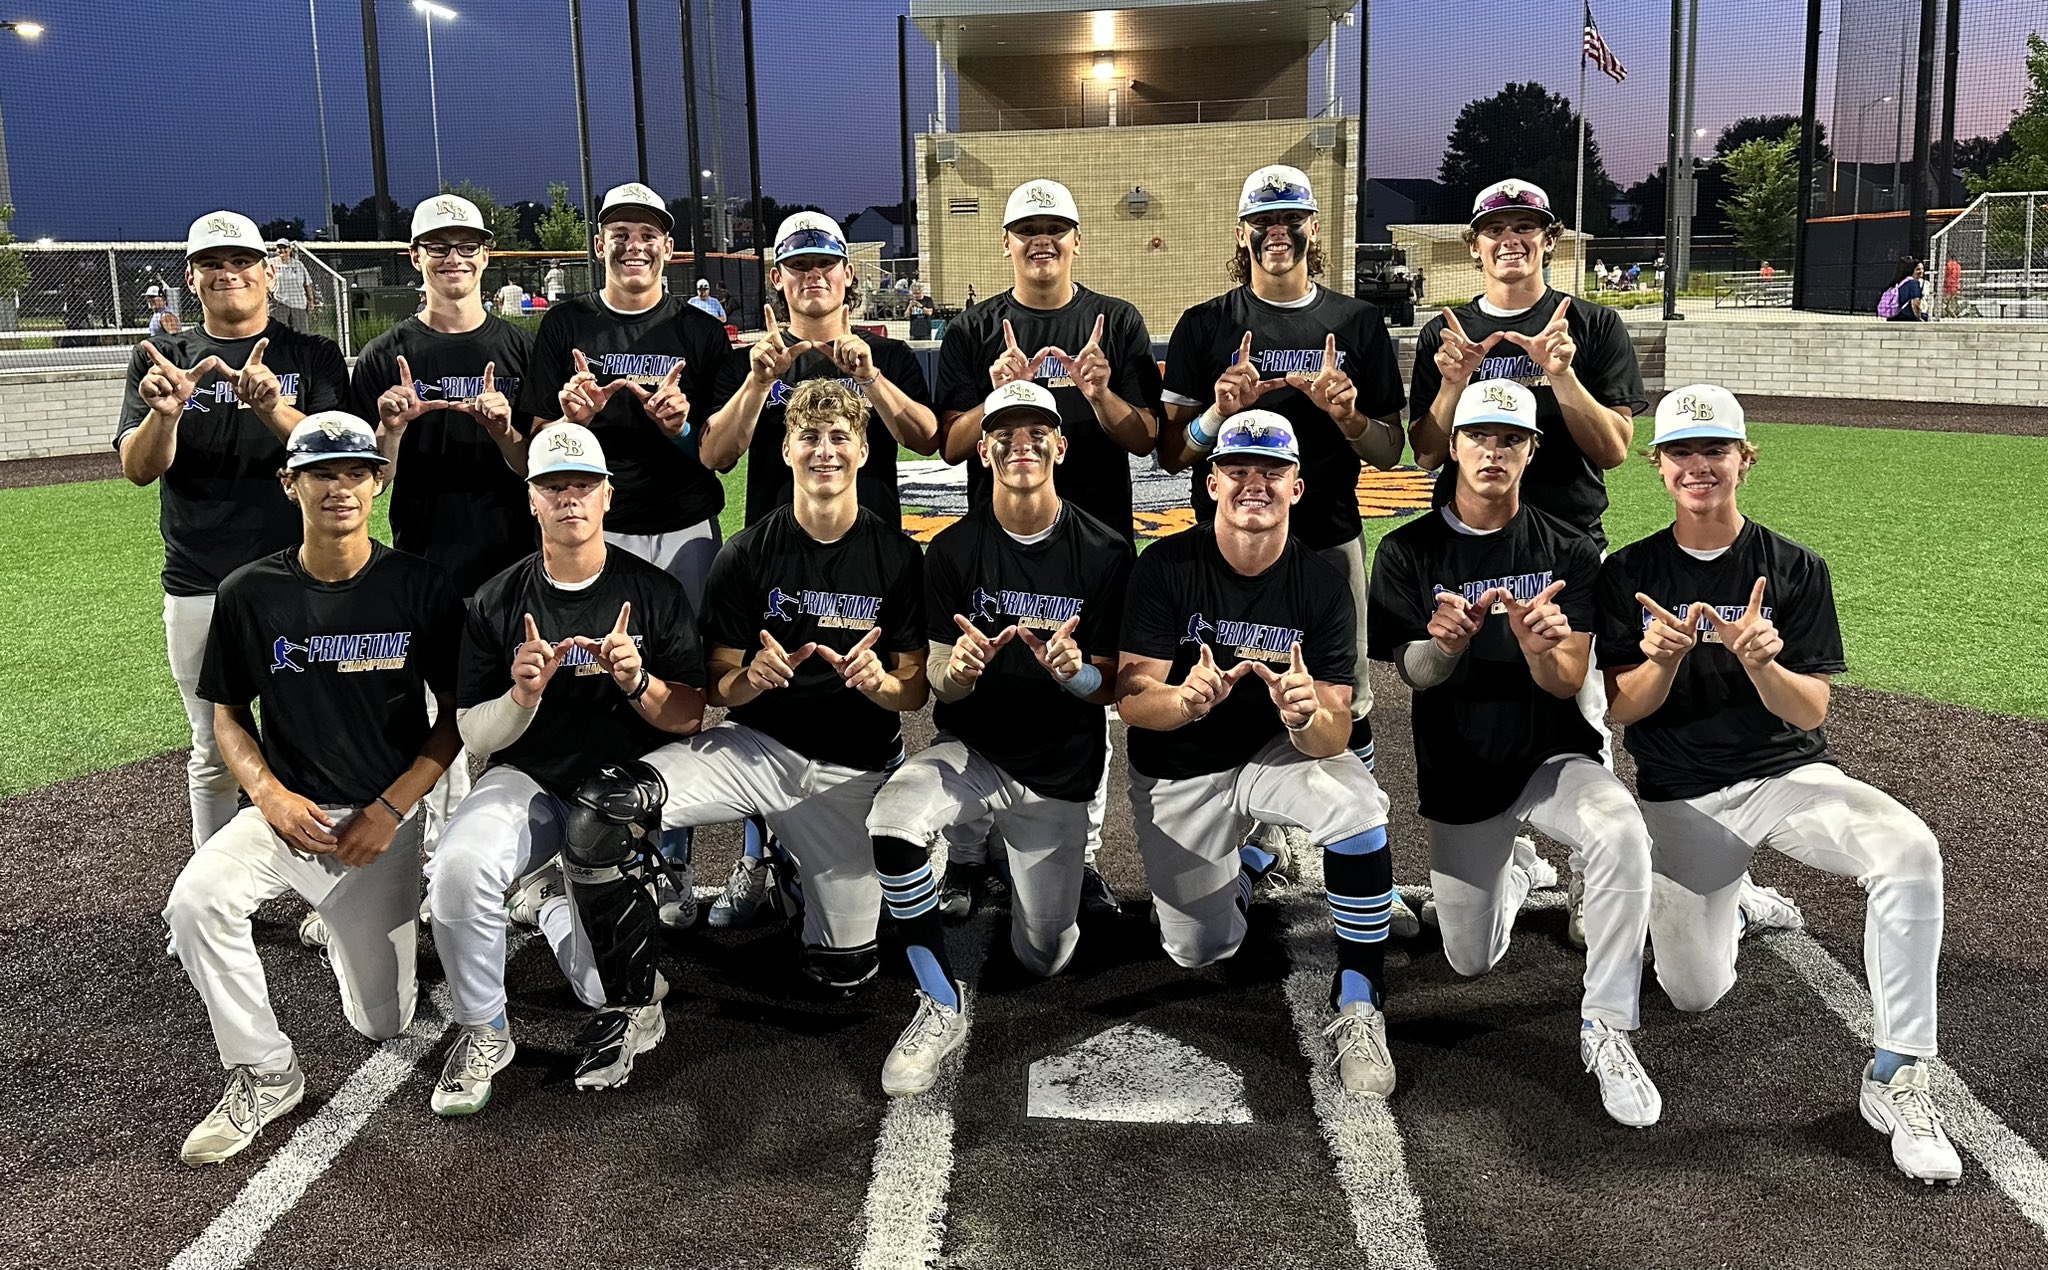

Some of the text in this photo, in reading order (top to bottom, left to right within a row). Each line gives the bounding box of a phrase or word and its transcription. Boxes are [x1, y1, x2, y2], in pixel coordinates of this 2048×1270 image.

[1026, 186, 1056, 208] RB
[436, 201, 468, 221] RB
[208, 217, 241, 238] RB
[1483, 385, 1518, 411] RB
[1676, 395, 1714, 421] RB
[548, 432, 584, 457] RB
[798, 590, 882, 620] PRIMETIME
[996, 590, 1084, 620] PRIMETIME
[817, 616, 876, 630] CHAMPIONS
[308, 632, 412, 662] PRIMETIME
[1216, 620, 1304, 652] PRIMETIME
[337, 657, 406, 672] CHAMPIONS
